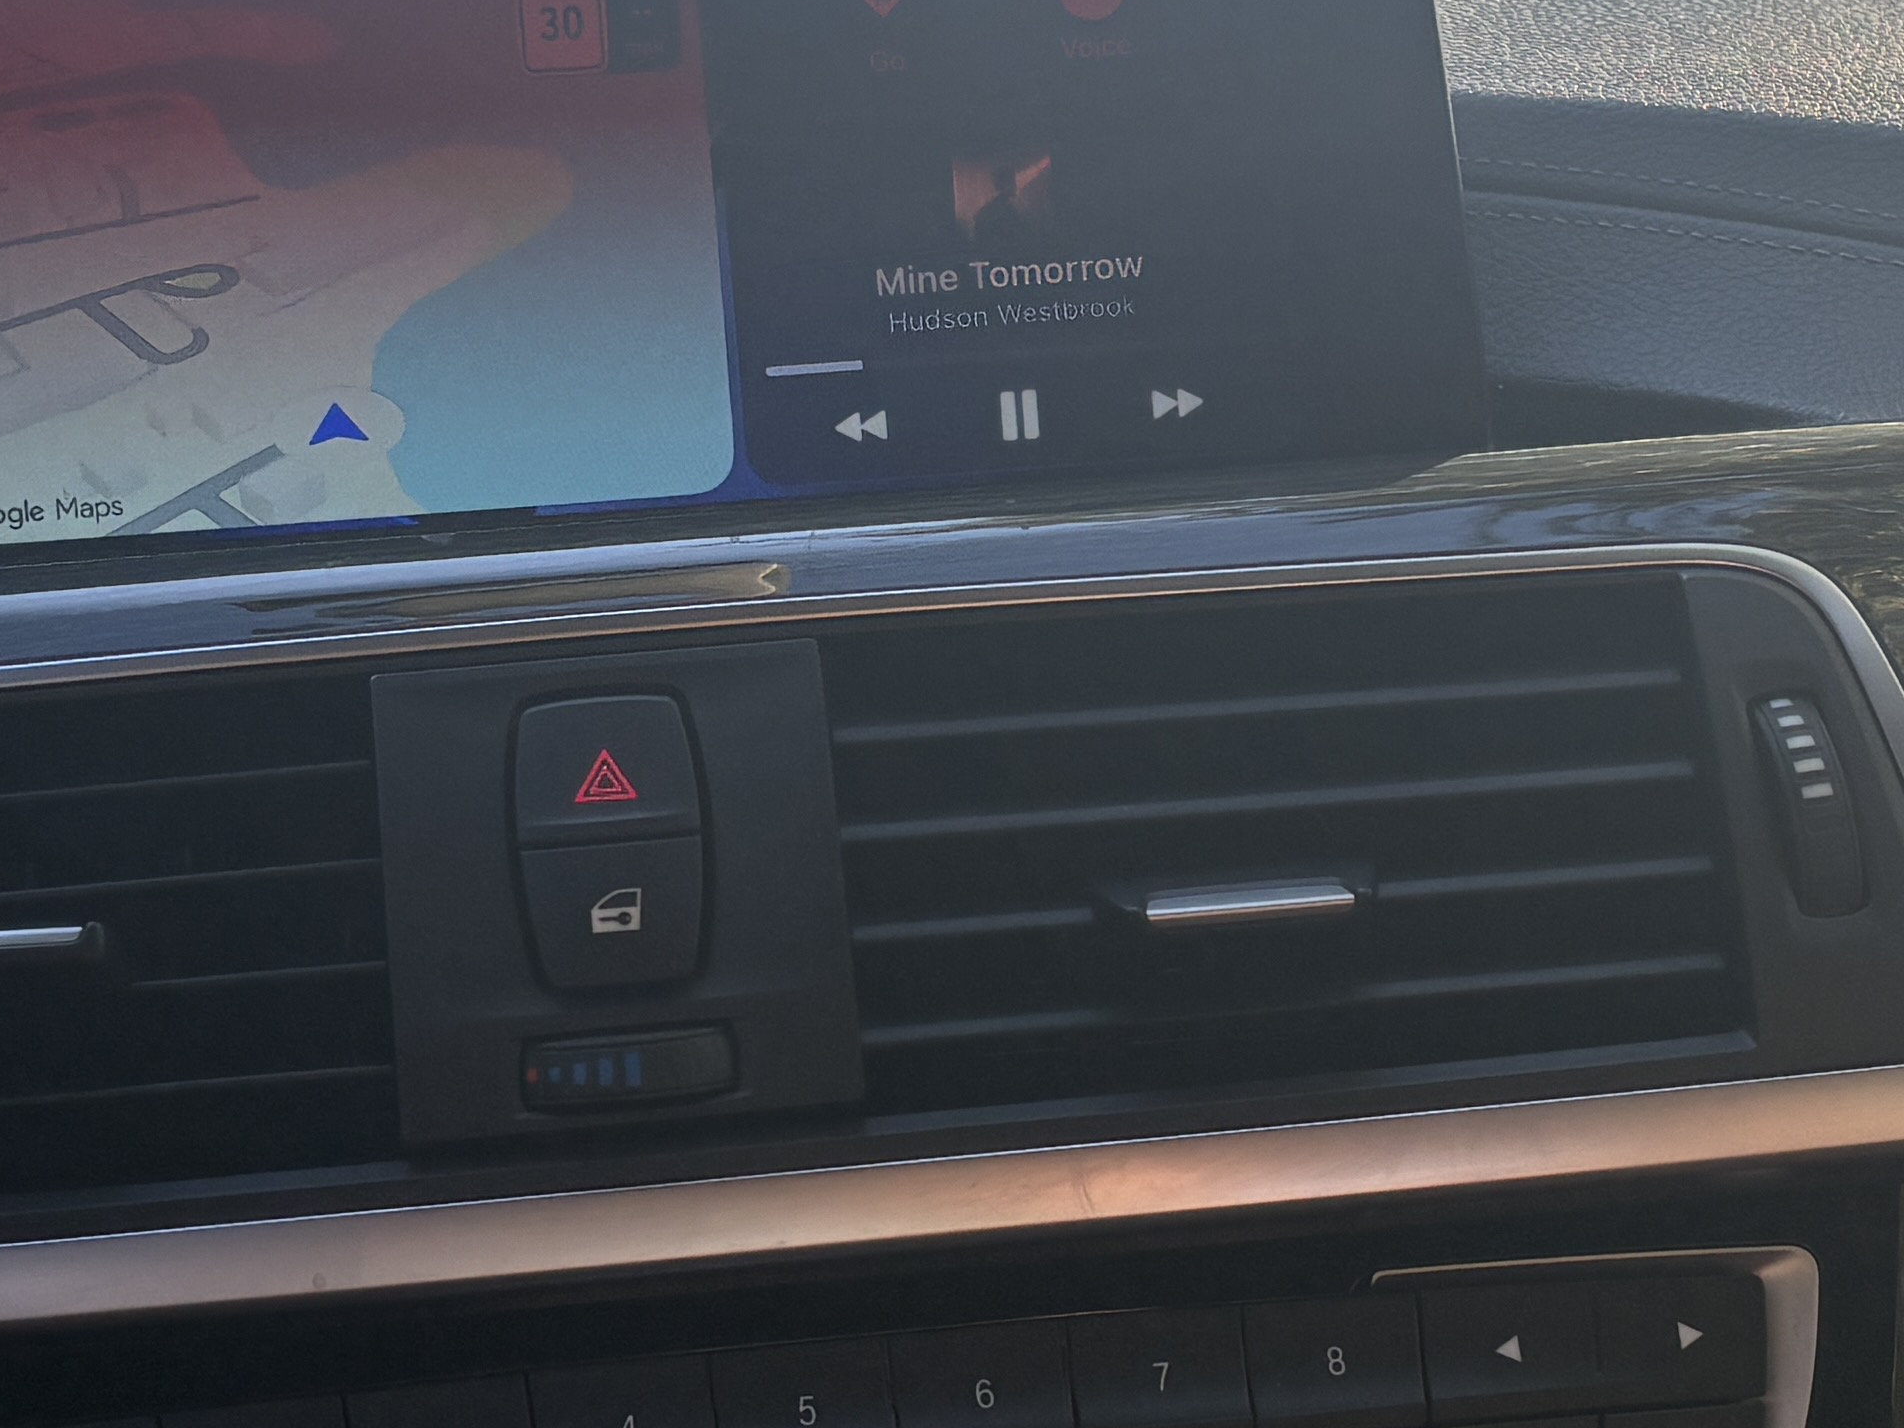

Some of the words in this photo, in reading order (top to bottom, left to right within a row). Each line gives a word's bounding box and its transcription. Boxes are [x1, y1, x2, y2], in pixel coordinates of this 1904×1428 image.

[541, 6, 583, 41] 30
[870, 51, 905, 72] Go
[1060, 37, 1132, 59] Voice
[876, 267, 957, 296] Mine
[968, 254, 1144, 289] Tomorrow
[889, 308, 988, 333] Hudson
[998, 298, 1135, 325] Westbrook
[56, 494, 124, 523] Maps
[1327, 1347, 1345, 1375] 8
[1152, 1361, 1169, 1391] 7
[976, 1379, 994, 1408] 6
[799, 1396, 816, 1425] 5
